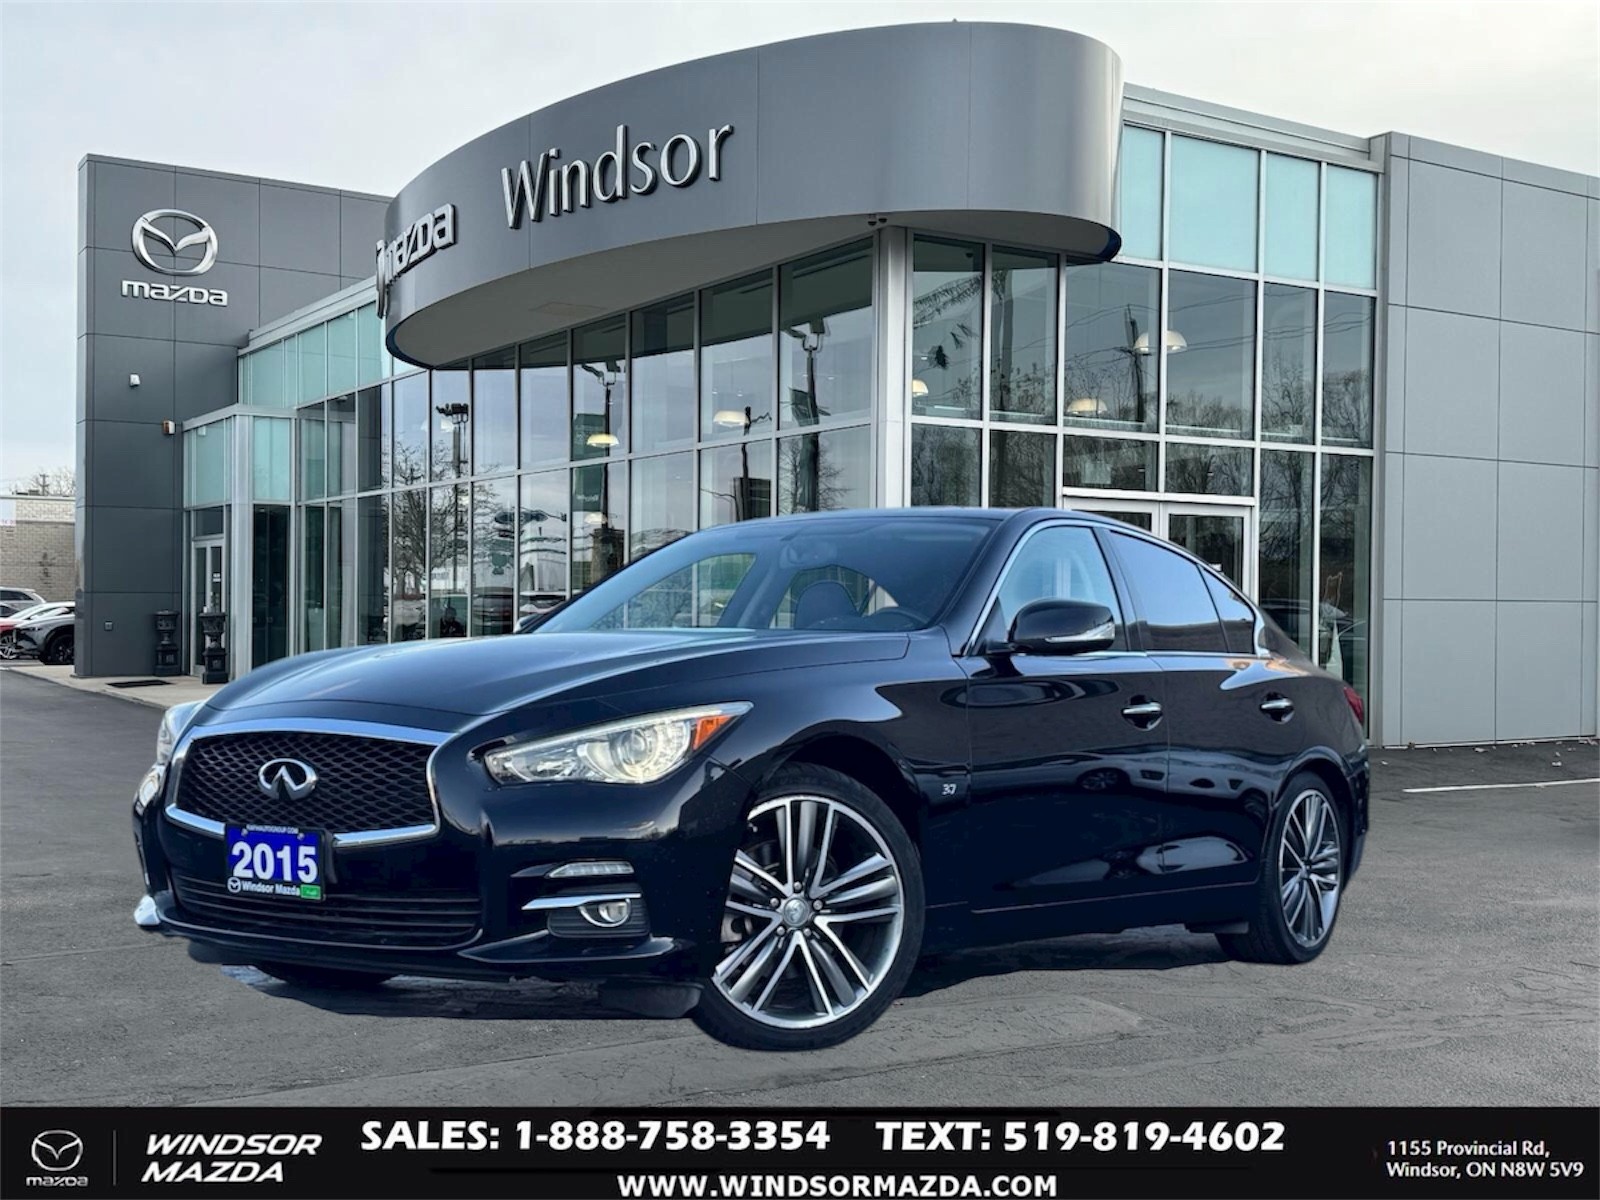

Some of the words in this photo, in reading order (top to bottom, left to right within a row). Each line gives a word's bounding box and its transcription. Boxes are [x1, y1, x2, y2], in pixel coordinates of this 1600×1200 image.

[501, 124, 734, 229] Windsor
[121, 279, 229, 307] mazda
[231, 841, 318, 883] 2015
[242, 880, 275, 893] Windsor
[275, 884, 300, 896] Mazda
